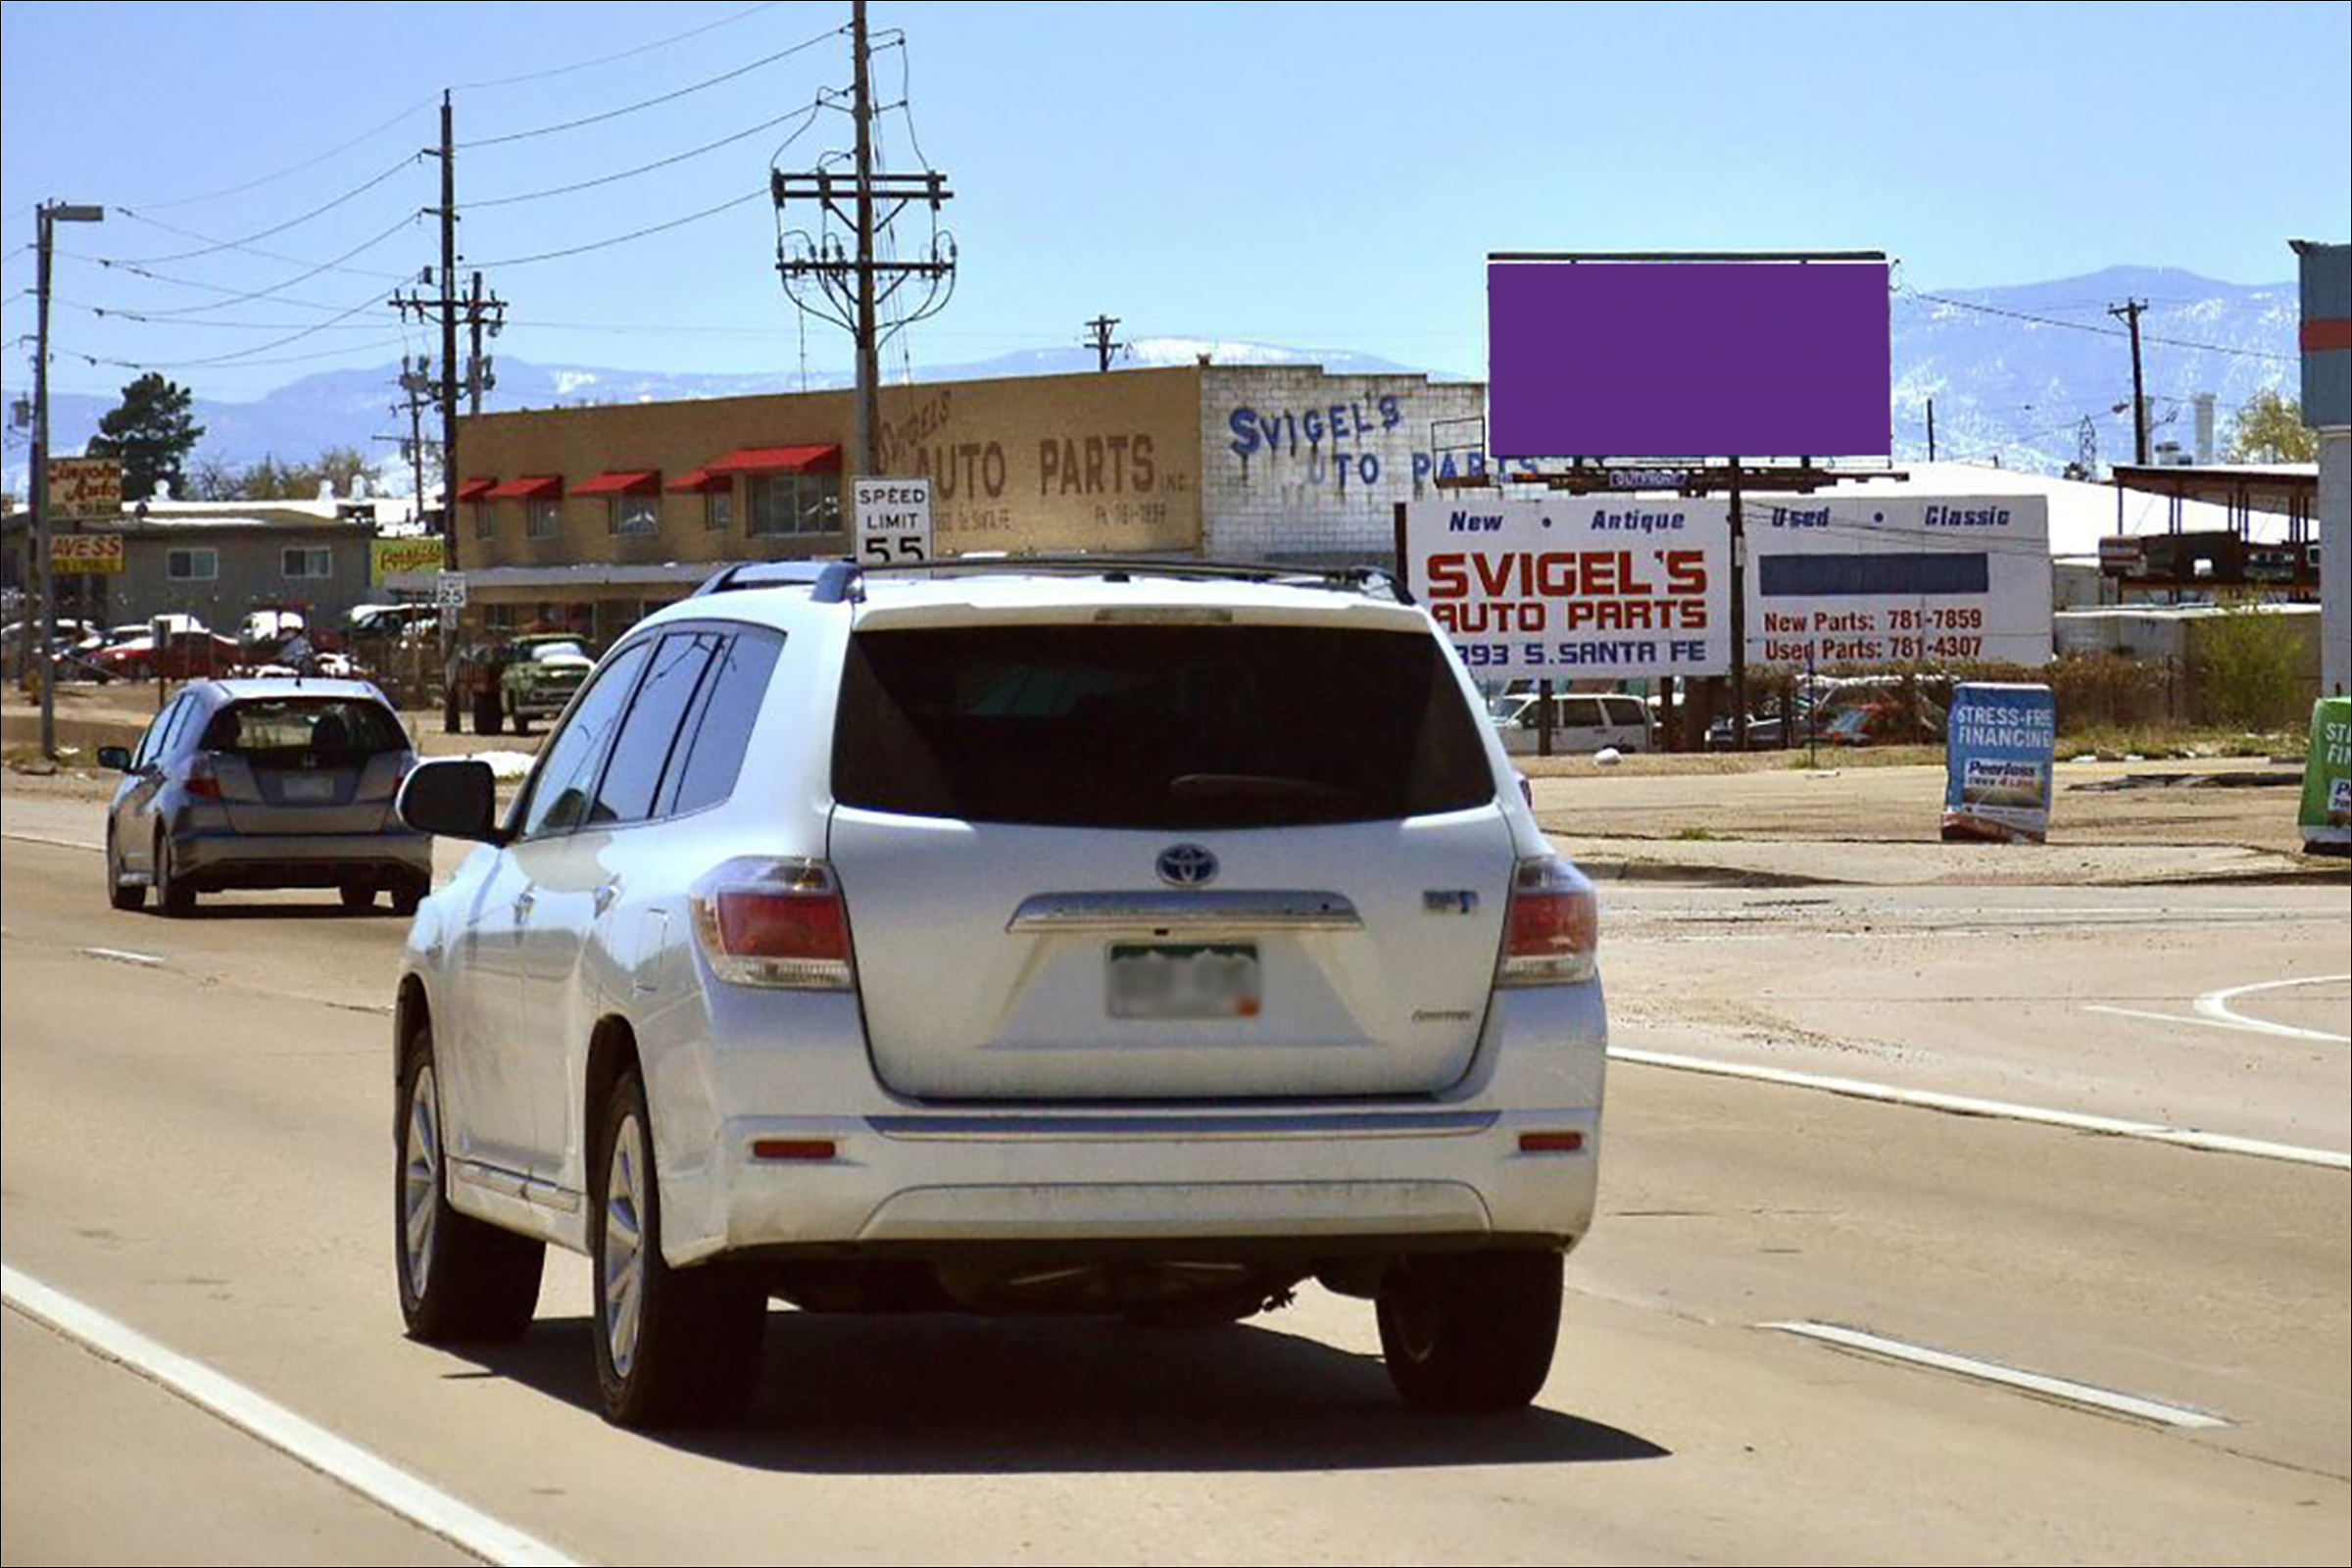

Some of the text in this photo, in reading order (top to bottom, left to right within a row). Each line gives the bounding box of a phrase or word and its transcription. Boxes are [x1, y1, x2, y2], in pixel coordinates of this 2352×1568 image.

[915, 442, 1006, 501] AUTO
[1039, 434, 1154, 496] PARTS
[858, 488, 926, 505] SPEED
[866, 514, 918, 530] LIMIT
[1449, 509, 1686, 534] New Antique
[1772, 505, 2011, 528] Used Classic
[865, 537, 924, 563] 55
[1427, 550, 1707, 599] SVIGEL'S
[439, 590, 465, 604] 25
[1431, 600, 1707, 633] AUTO PARTS
[1764, 609, 1983, 632] New Parts: 781-7859
[1670, 642, 1706, 662] FE
[1765, 636, 1983, 661] Used Parts: 781-4307
